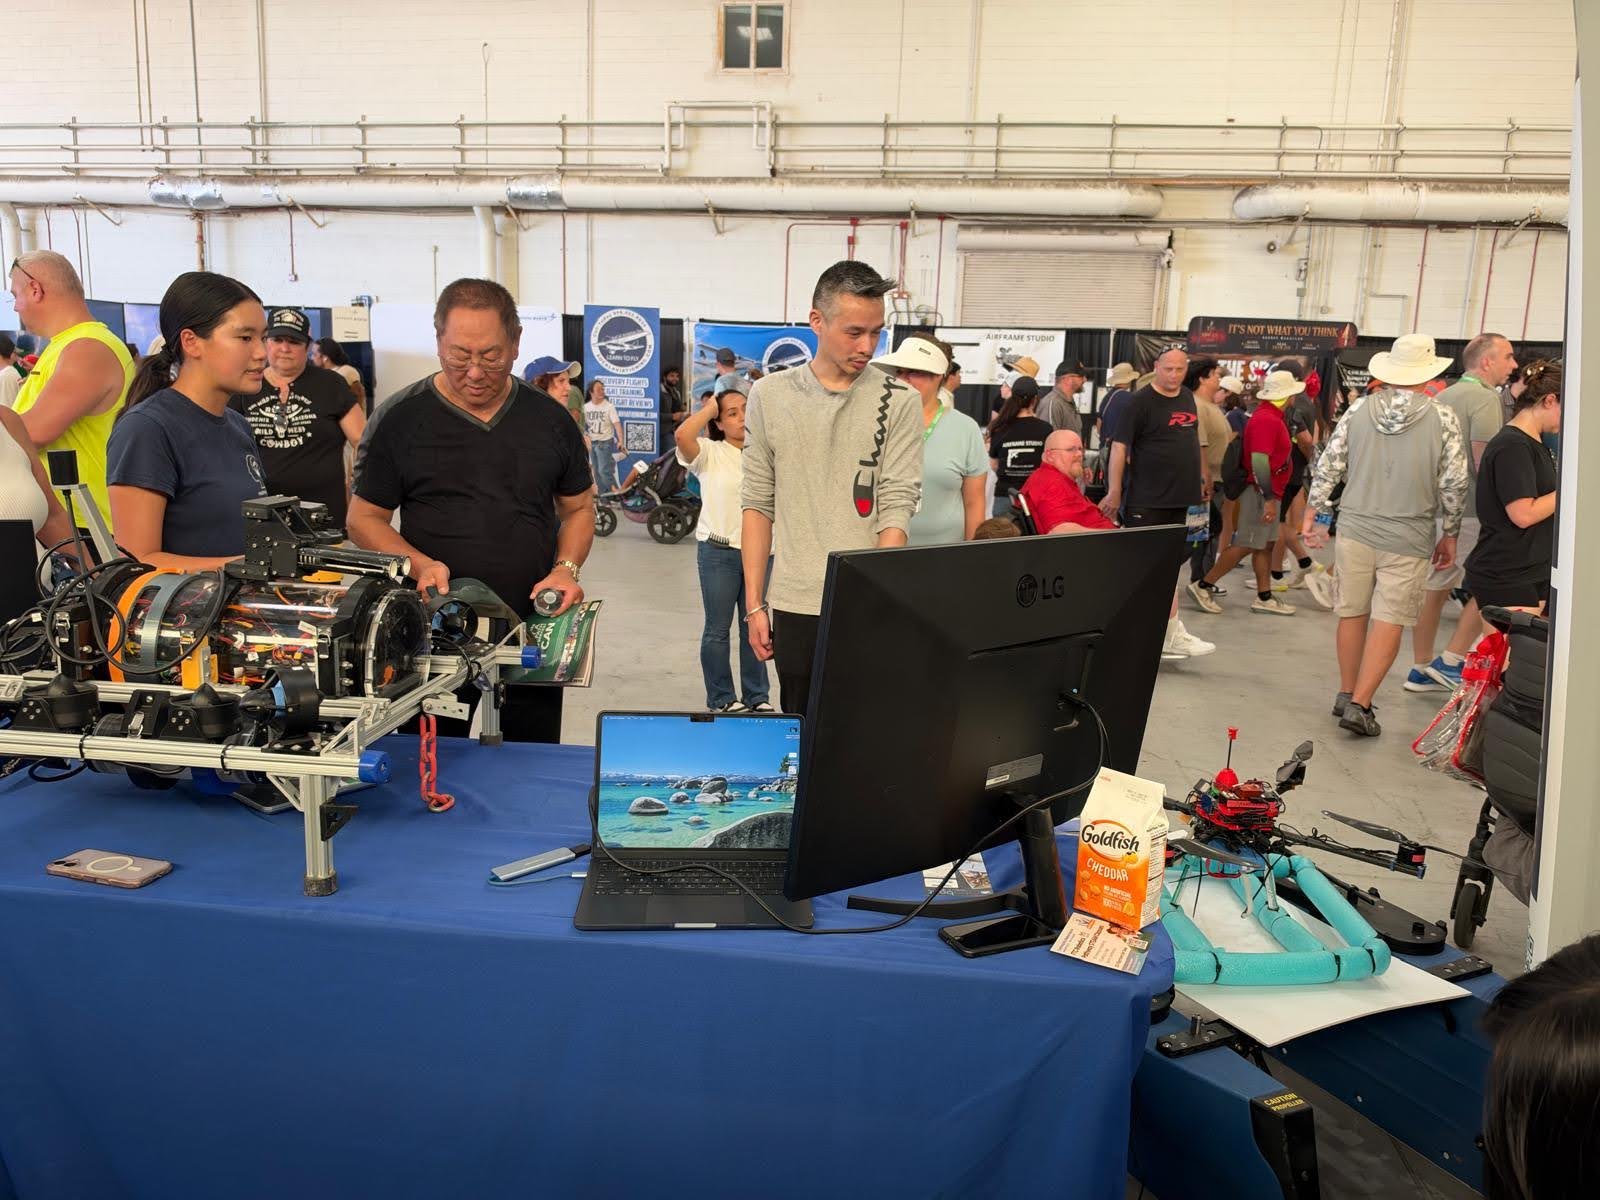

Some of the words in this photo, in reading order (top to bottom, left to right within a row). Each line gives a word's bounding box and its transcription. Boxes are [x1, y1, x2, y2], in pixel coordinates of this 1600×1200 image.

[986, 333, 1024, 341] AIRFRAME
[1228, 323, 1246, 335] IT'S
[1247, 324, 1265, 336] NOT
[1267, 325, 1292, 336] WHAT
[1294, 326, 1311, 336] YOU
[1312, 326, 1338, 337] THINK
[260, 436, 304, 448] COWBOY
[1002, 440, 1025, 448] AIRFRAME
[541, 622, 556, 650] CAN
[1081, 824, 1140, 853] Goldfish
[1086, 857, 1130, 883] CHEDDAR
[1263, 1092, 1298, 1106] CAUTION
[1271, 1099, 1305, 1111] PROPELLER
